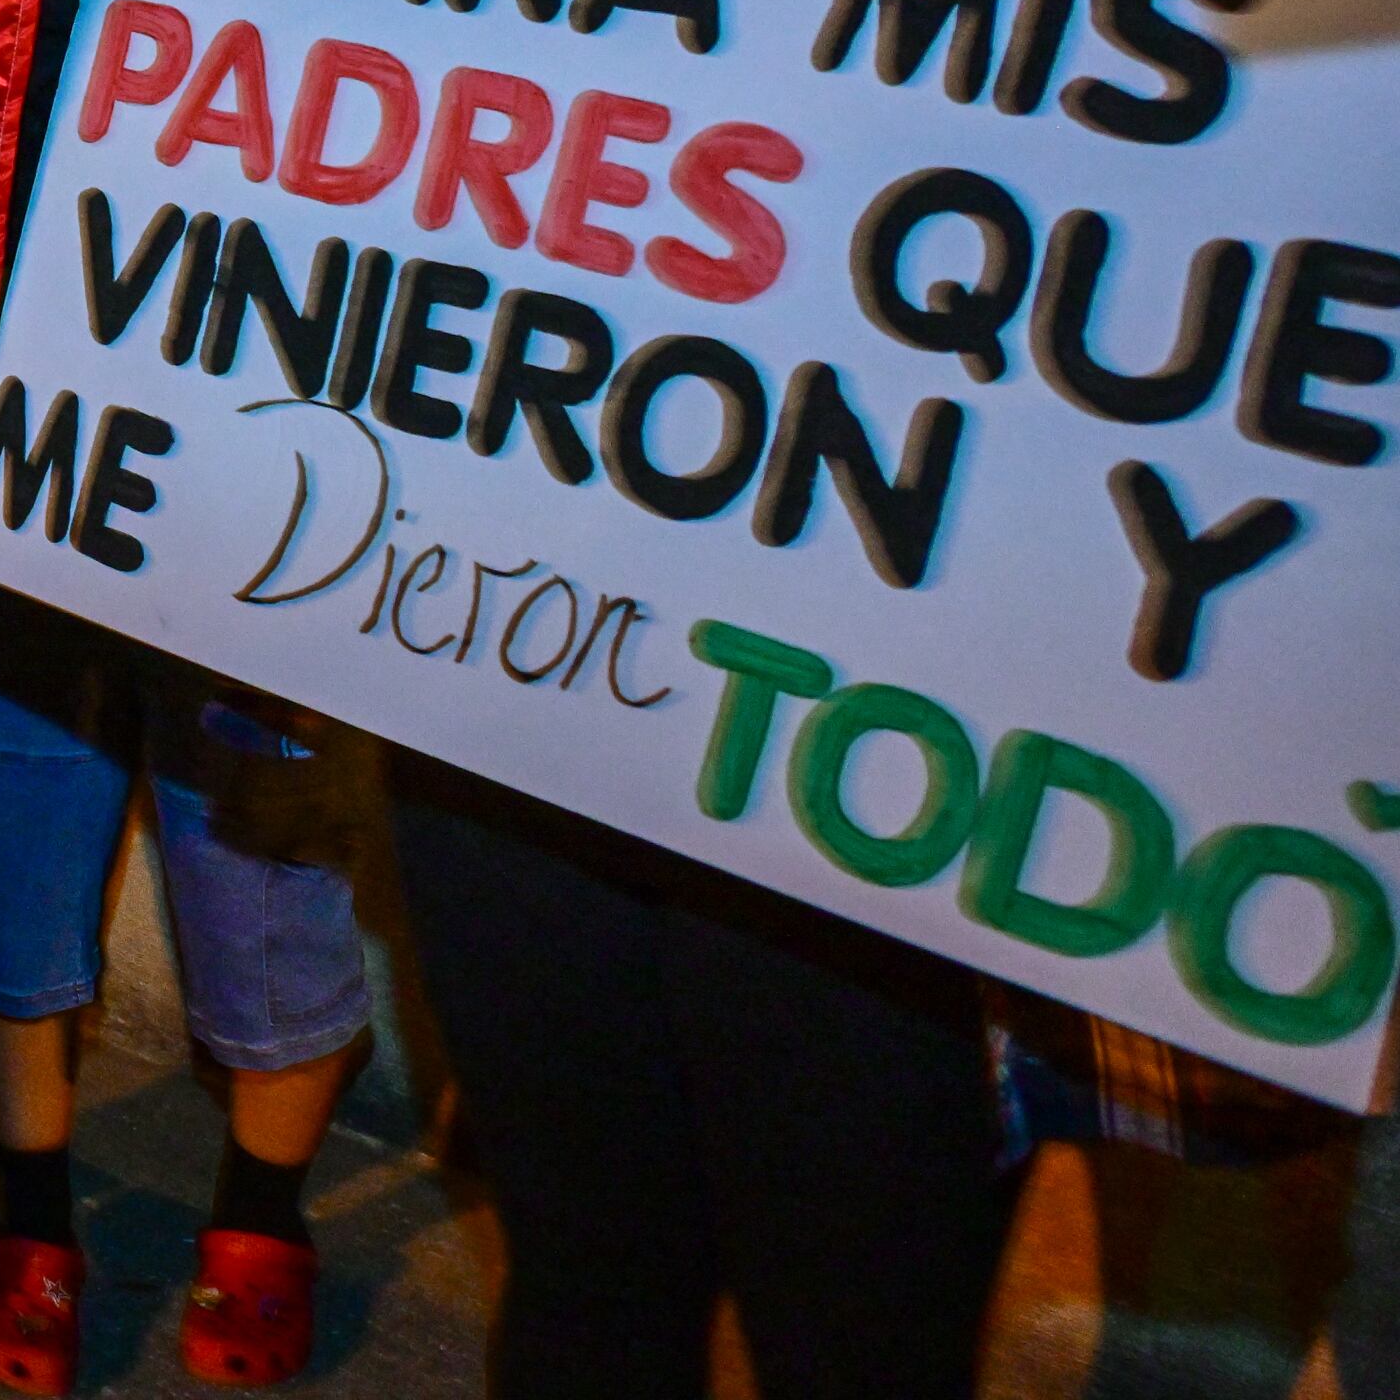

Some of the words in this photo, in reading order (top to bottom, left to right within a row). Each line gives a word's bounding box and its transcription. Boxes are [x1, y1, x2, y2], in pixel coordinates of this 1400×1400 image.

[76, 188, 964, 589] VINIERON
[1107, 460, 1302, 683] Y
[849, 167, 1400, 467] QUE
[233, 400, 673, 707] Dieron
[688, 619, 1400, 1047] TODO
